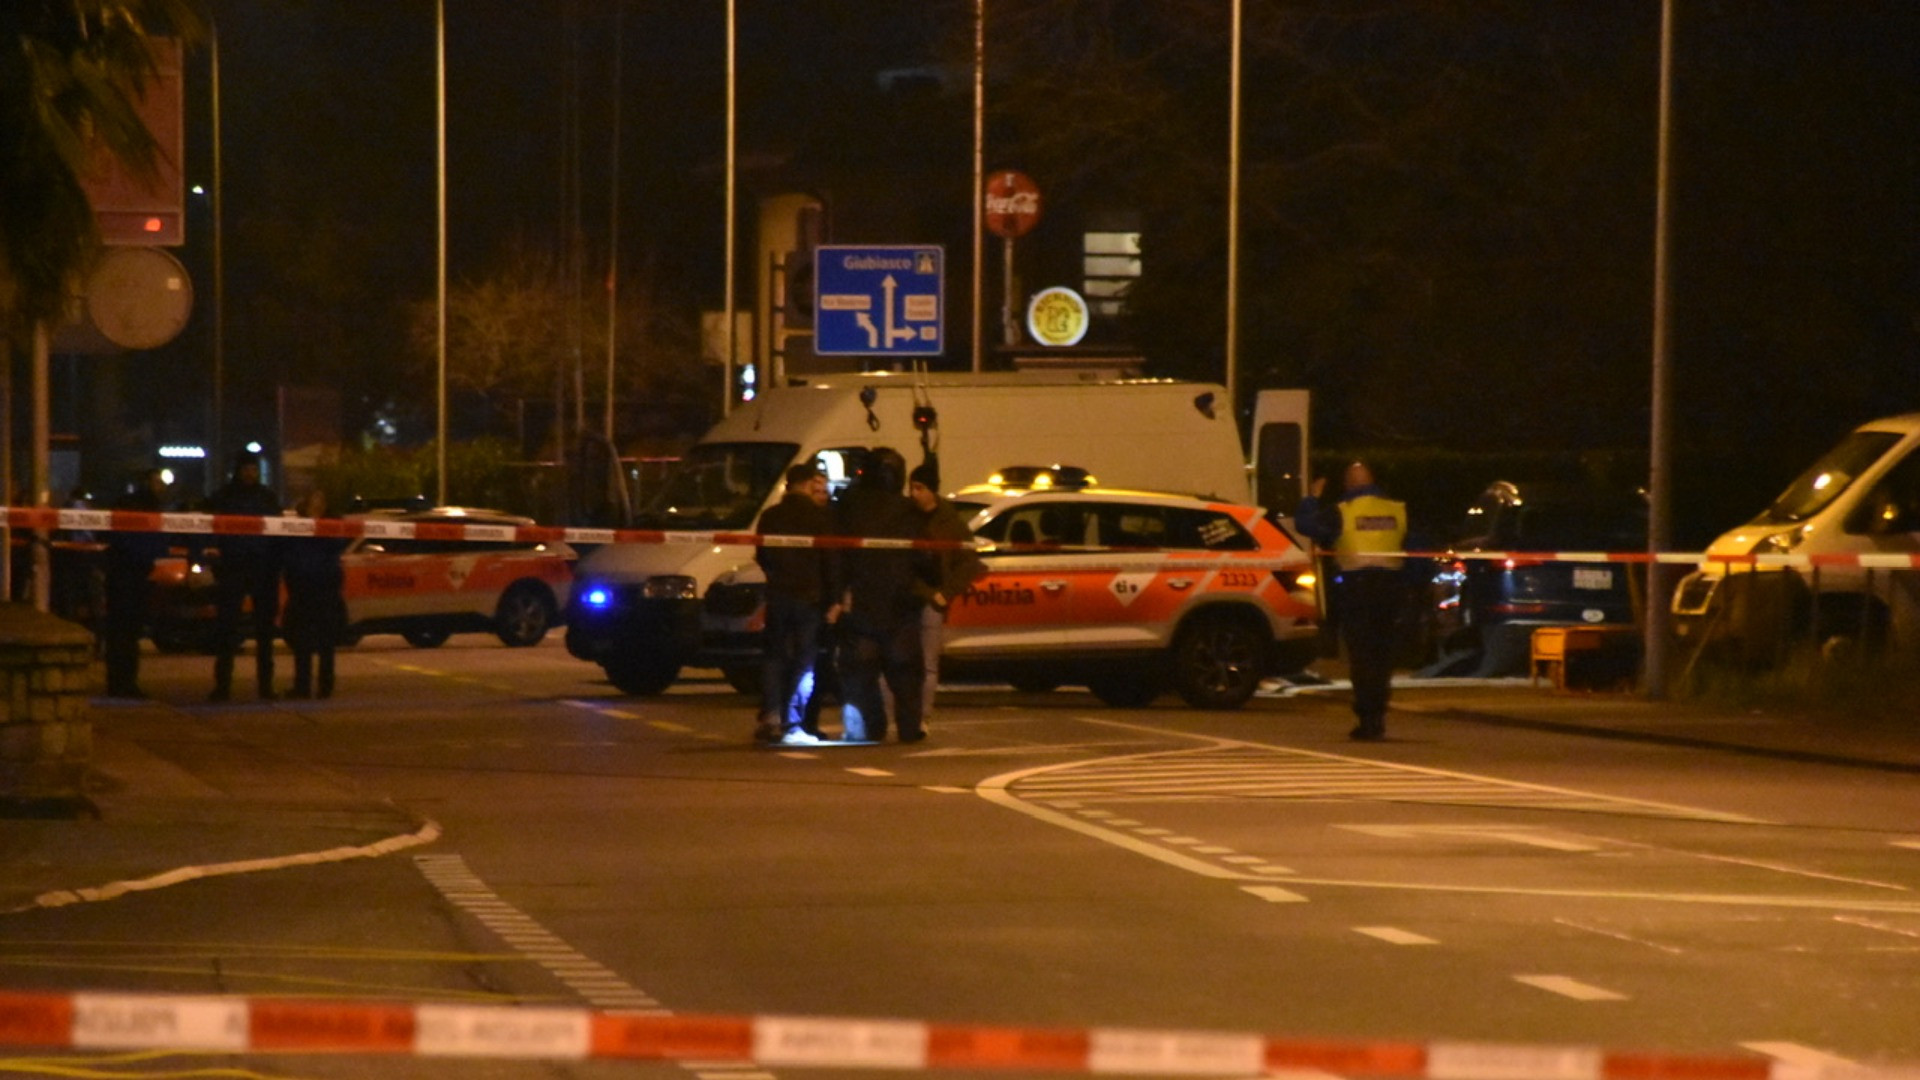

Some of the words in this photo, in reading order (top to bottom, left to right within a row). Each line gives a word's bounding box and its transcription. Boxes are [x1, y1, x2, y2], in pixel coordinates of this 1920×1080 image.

[843, 255, 912, 270] Giubiasco
[1218, 571, 1258, 587] 2323
[962, 582, 1035, 606] Polizia
